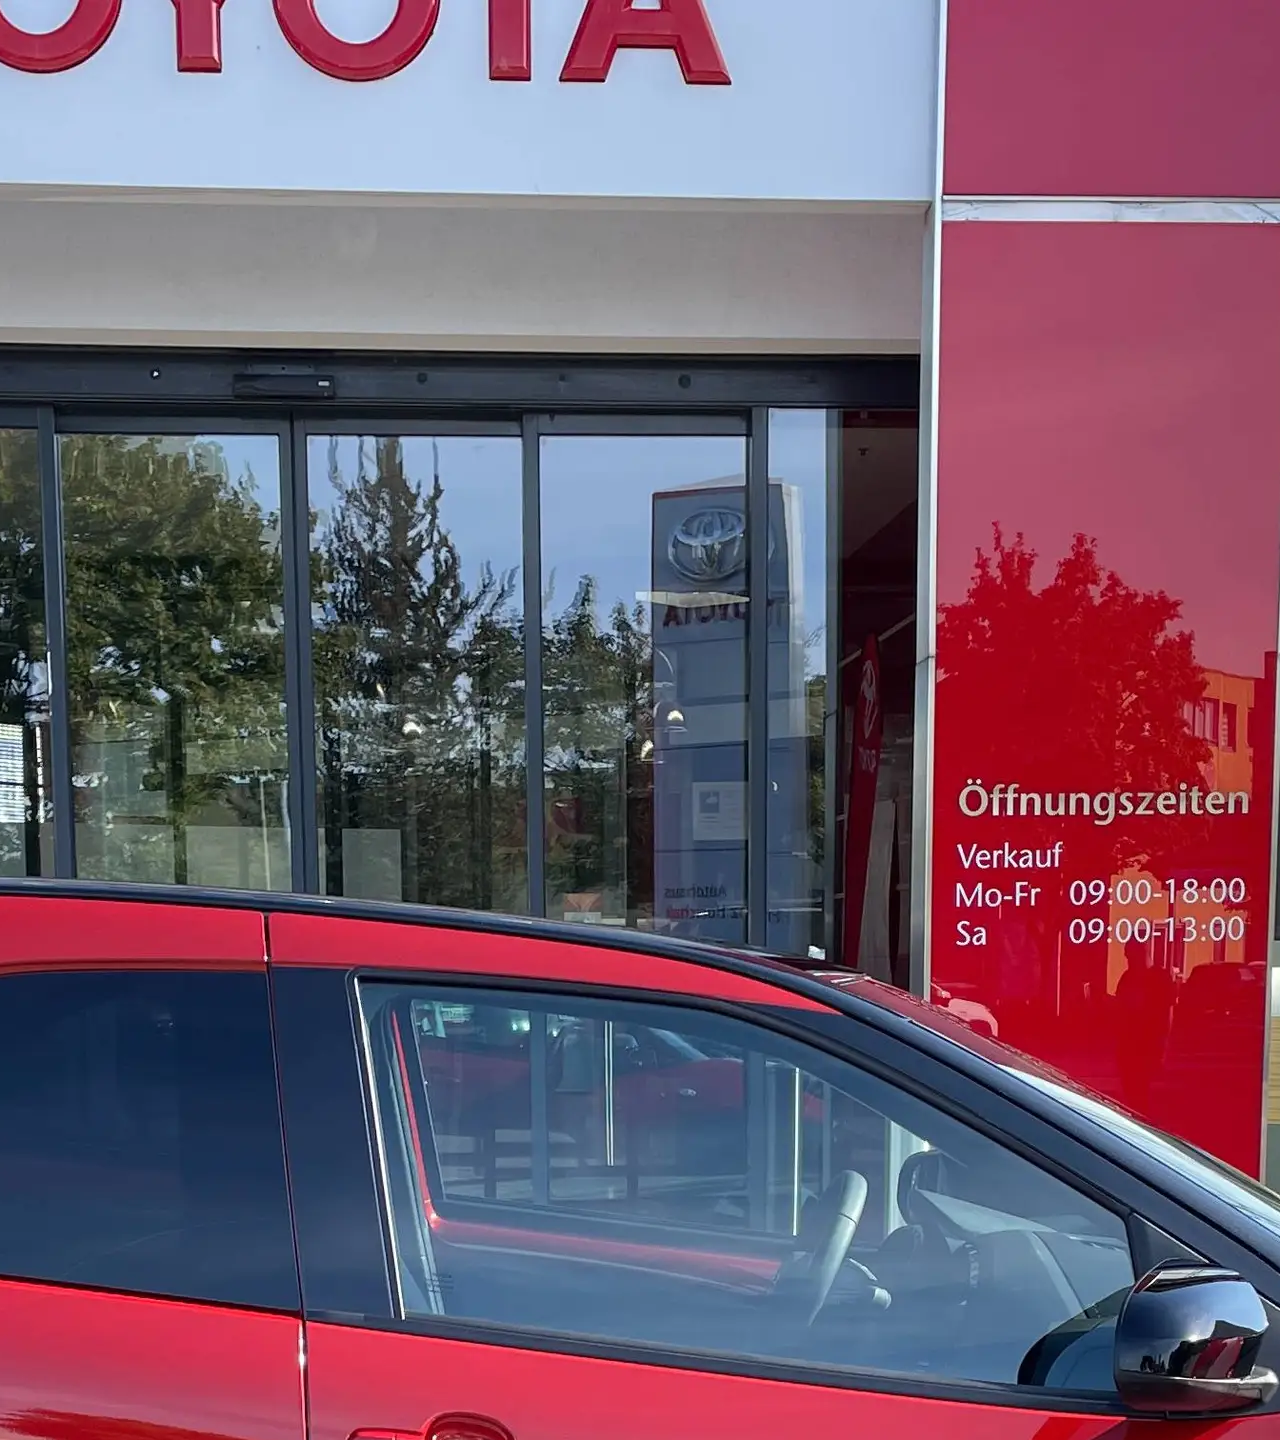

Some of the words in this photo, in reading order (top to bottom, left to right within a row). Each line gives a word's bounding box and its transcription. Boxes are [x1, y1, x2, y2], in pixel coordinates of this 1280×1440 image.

[958, 778, 1250, 825] Öffnungszeiten
[956, 841, 1064, 869] Verkauf
[955, 881, 1041, 908] Mo-Fr
[1069, 877, 1247, 906] 09:00-18:00
[956, 920, 987, 946] Sa
[1068, 916, 1246, 944] 09:00-13:00
